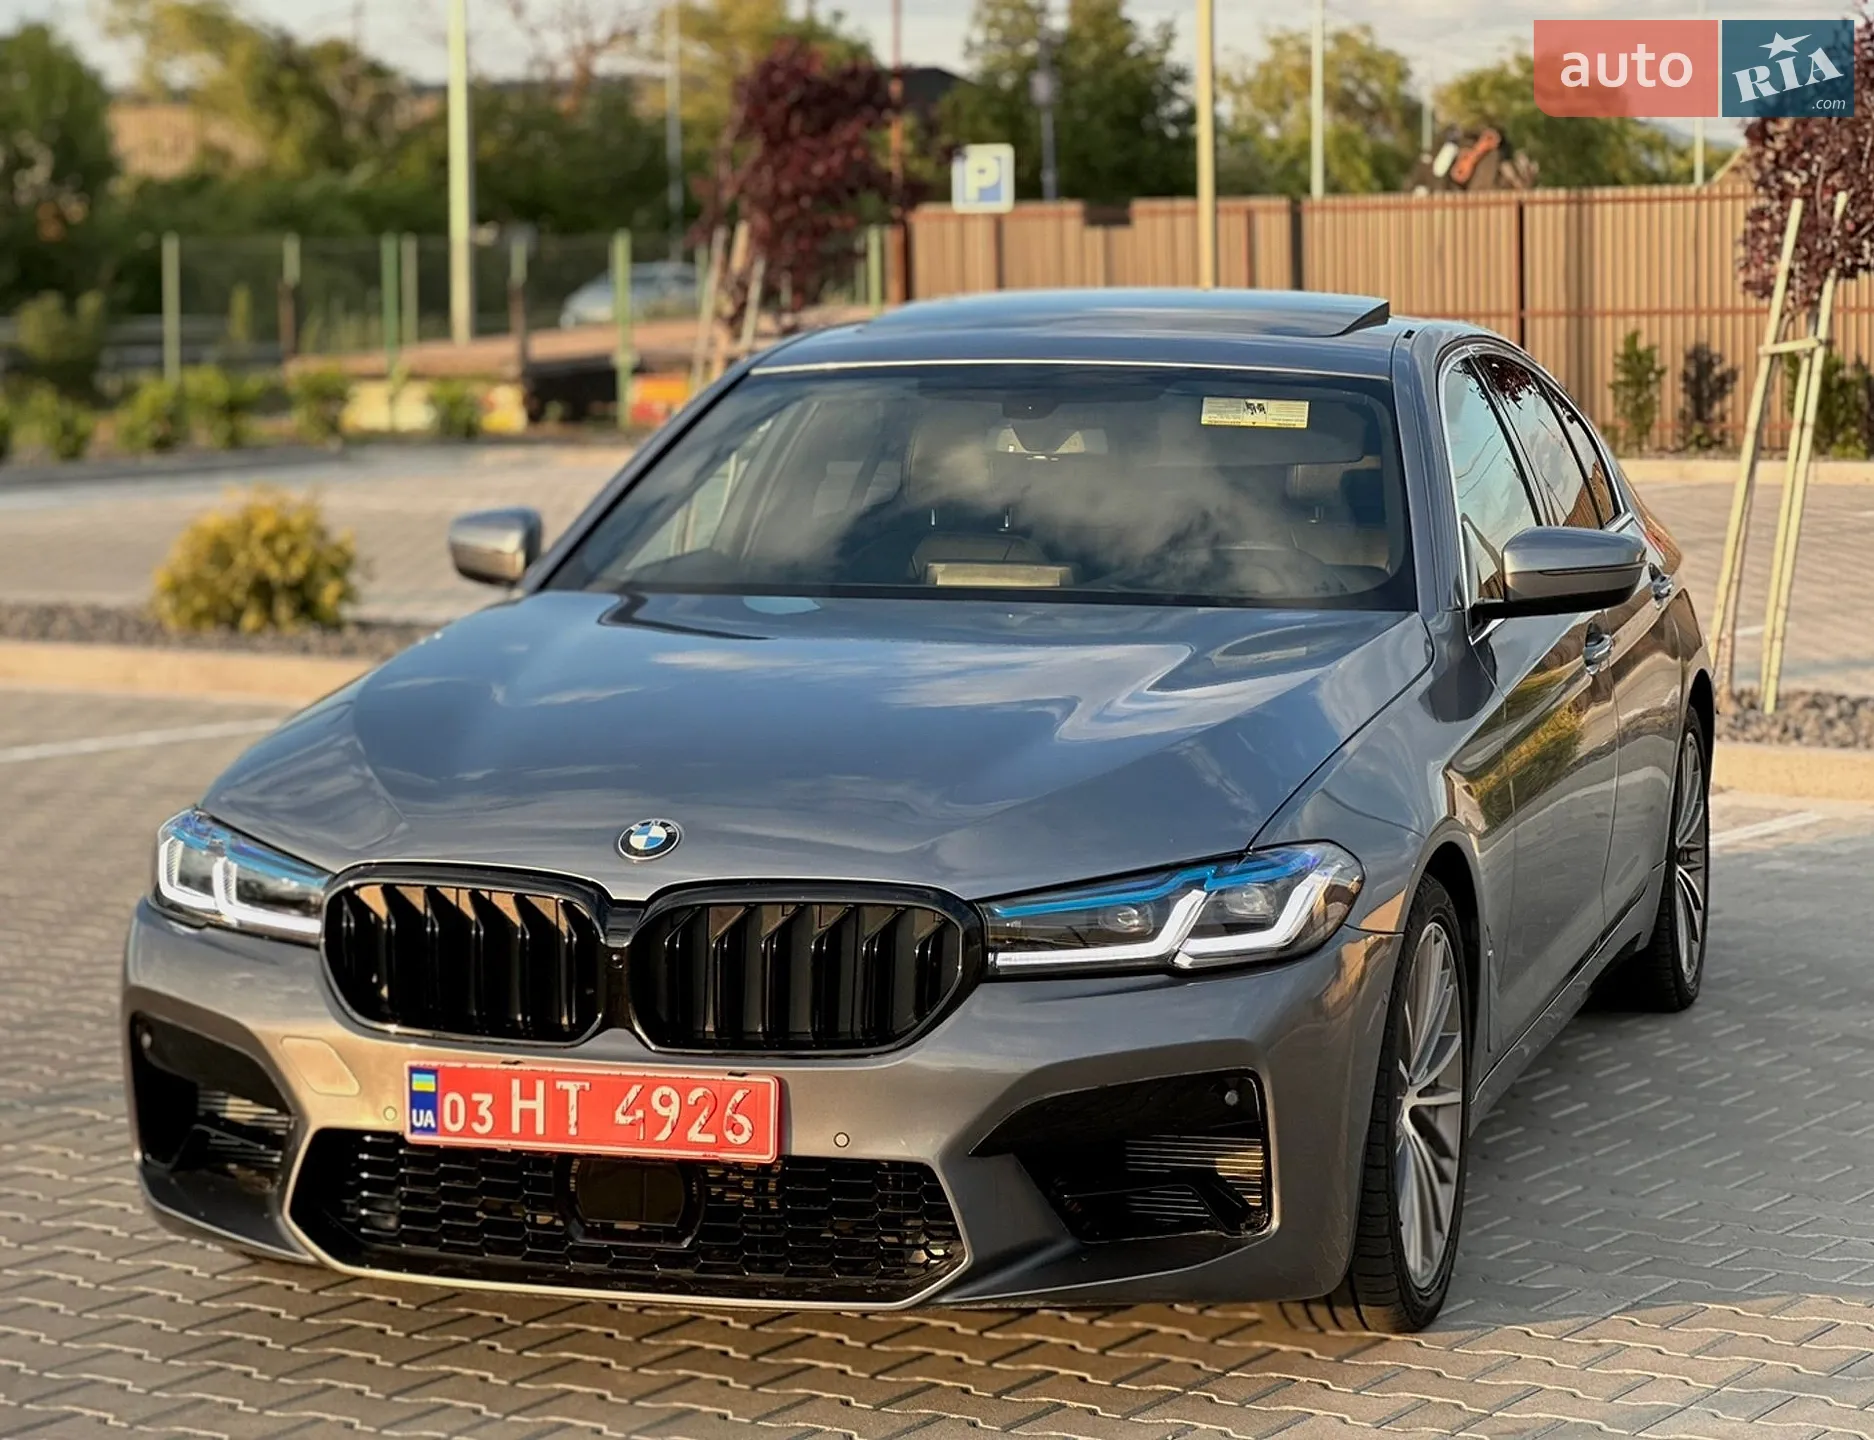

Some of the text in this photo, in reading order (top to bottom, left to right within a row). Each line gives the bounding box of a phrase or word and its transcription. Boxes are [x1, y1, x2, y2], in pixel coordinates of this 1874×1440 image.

[964, 158, 1001, 202] P
[411, 1108, 436, 1129] UA
[442, 1078, 754, 1146] 03 HT 4926
